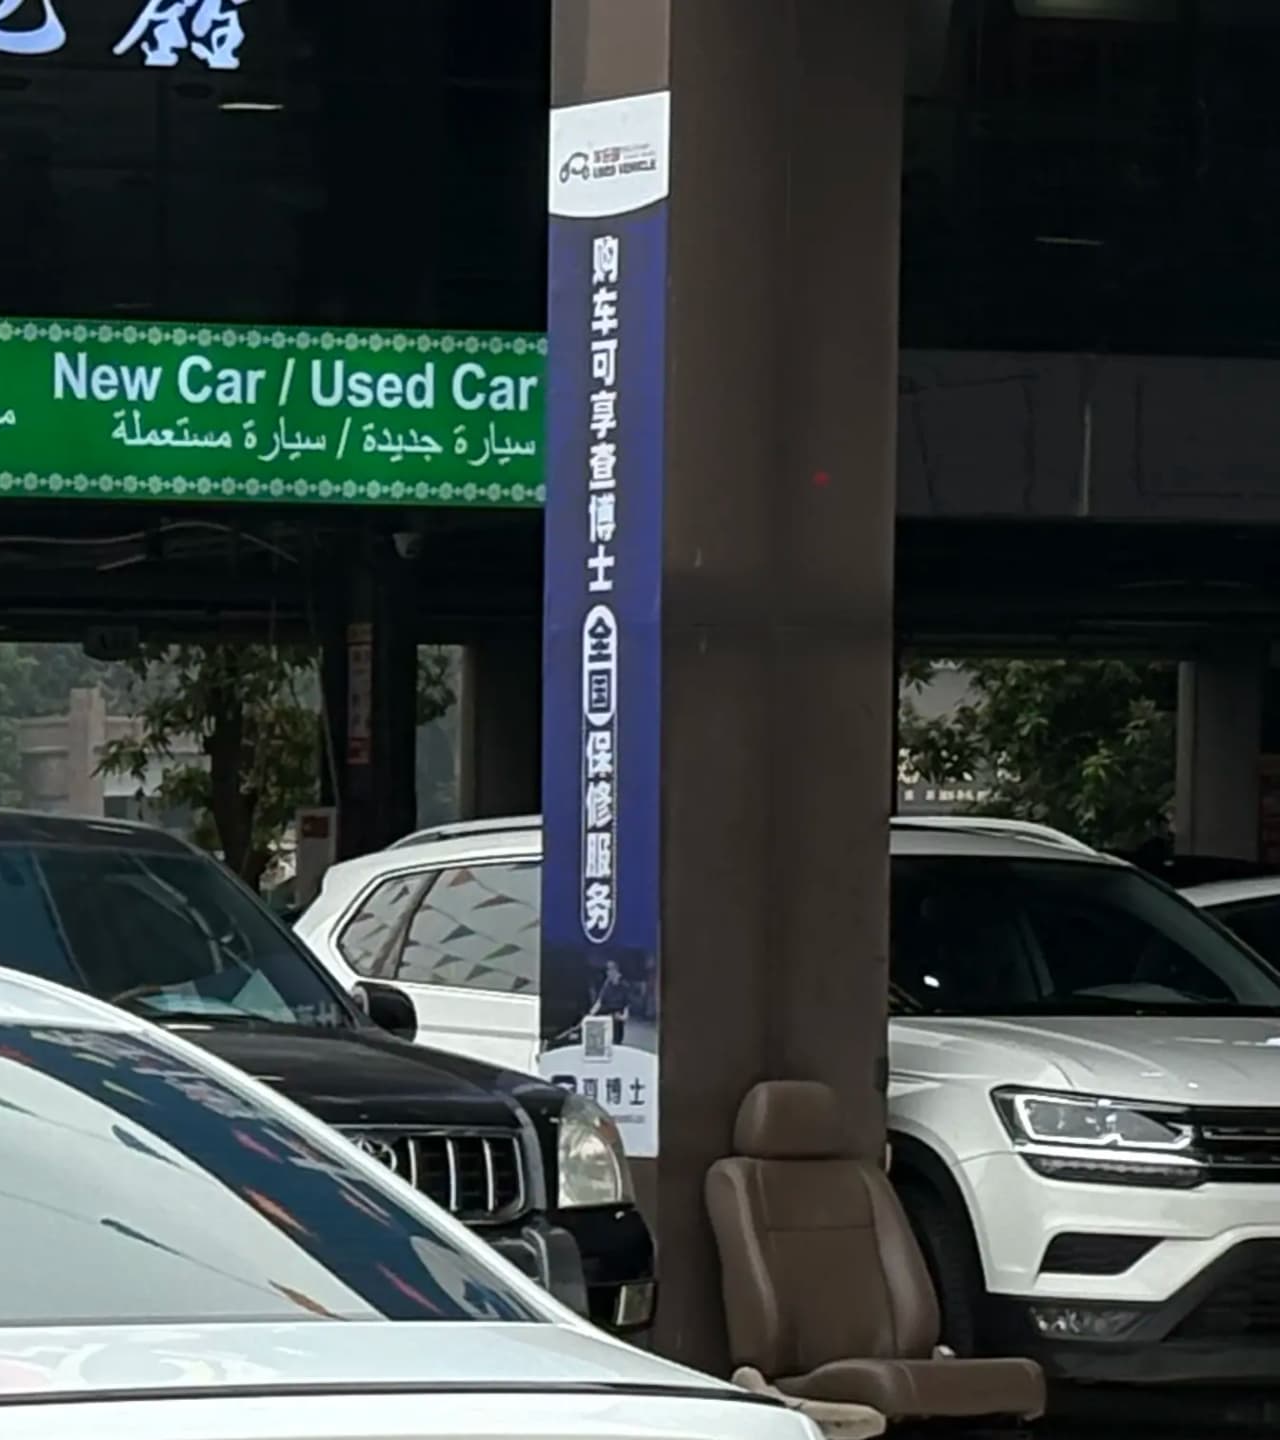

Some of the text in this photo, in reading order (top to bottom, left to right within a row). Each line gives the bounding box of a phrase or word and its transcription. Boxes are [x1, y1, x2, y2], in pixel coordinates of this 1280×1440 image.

[52, 351, 163, 402] New
[177, 354, 267, 405] Car
[310, 359, 435, 409] Used
[451, 361, 539, 412] Car
[111, 408, 234, 449] مستعملة
[587, 235, 620, 593] 购车可享查博士
[241, 416, 327, 461] سيارة
[361, 422, 444, 463] جديدة
[453, 421, 537, 467] سيارة
